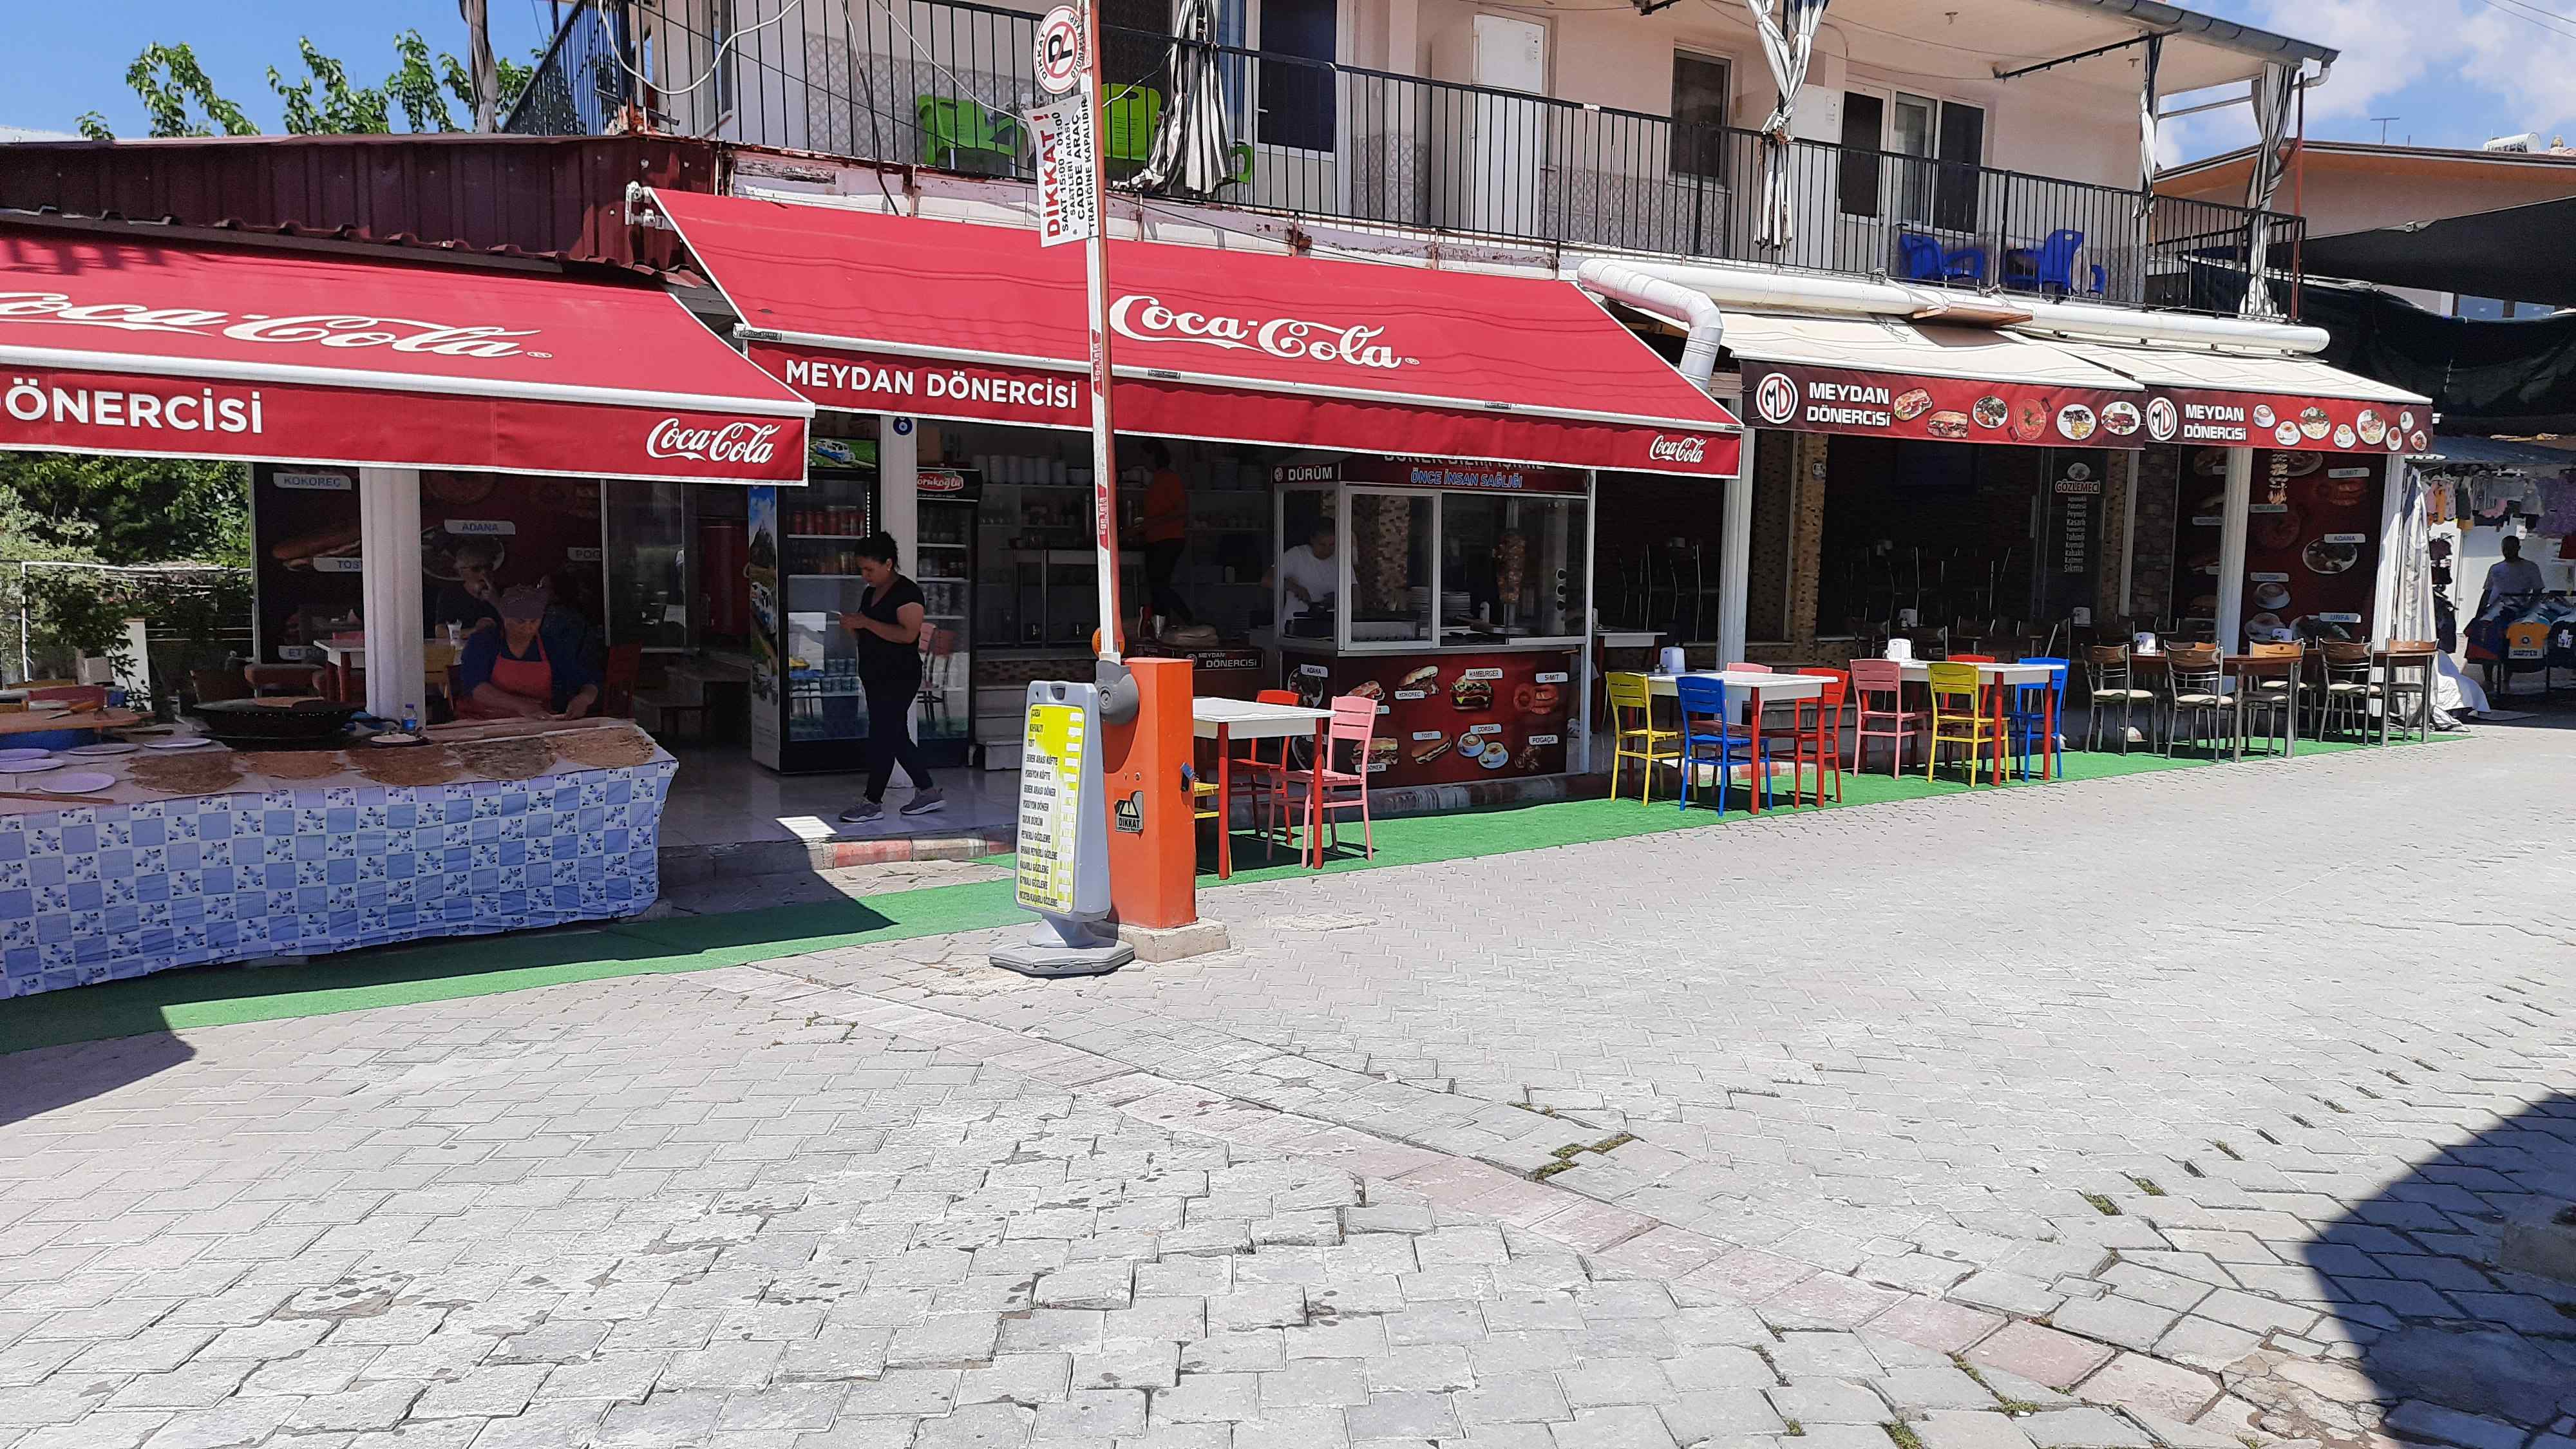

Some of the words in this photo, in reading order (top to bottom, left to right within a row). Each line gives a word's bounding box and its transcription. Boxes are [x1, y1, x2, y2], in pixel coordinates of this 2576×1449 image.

[1052, 112, 1063, 146] 01:00
[1072, 114, 1082, 159] ARAÇ
[1081, 100, 1092, 163] KAPALIDIR
[1040, 130, 1061, 237] DİKKAT
[1058, 158, 1067, 194] 15:00
[1075, 164, 1084, 220] CADDE
[1109, 295, 1401, 368] Coca-Cola
[786, 359, 913, 395] MEYDAN
[1809, 382, 1889, 404] MEYDAN
[0, 377, 262, 433] ÖNERCİSİ
[2185, 404, 2244, 422] MEYDAN
[646, 417, 781, 464] Coca-Cola
[1649, 435, 1707, 464] Coca-Cola
[1288, 465, 1332, 481] DÜRÜM
[1411, 468, 1443, 484] ÖNCE
[1481, 472, 1523, 488] SAĞLIĞI
[462, 524, 498, 532] ADANA
[337, 560, 361, 570] TOS
[1119, 817, 1140, 828] DIKKAT
